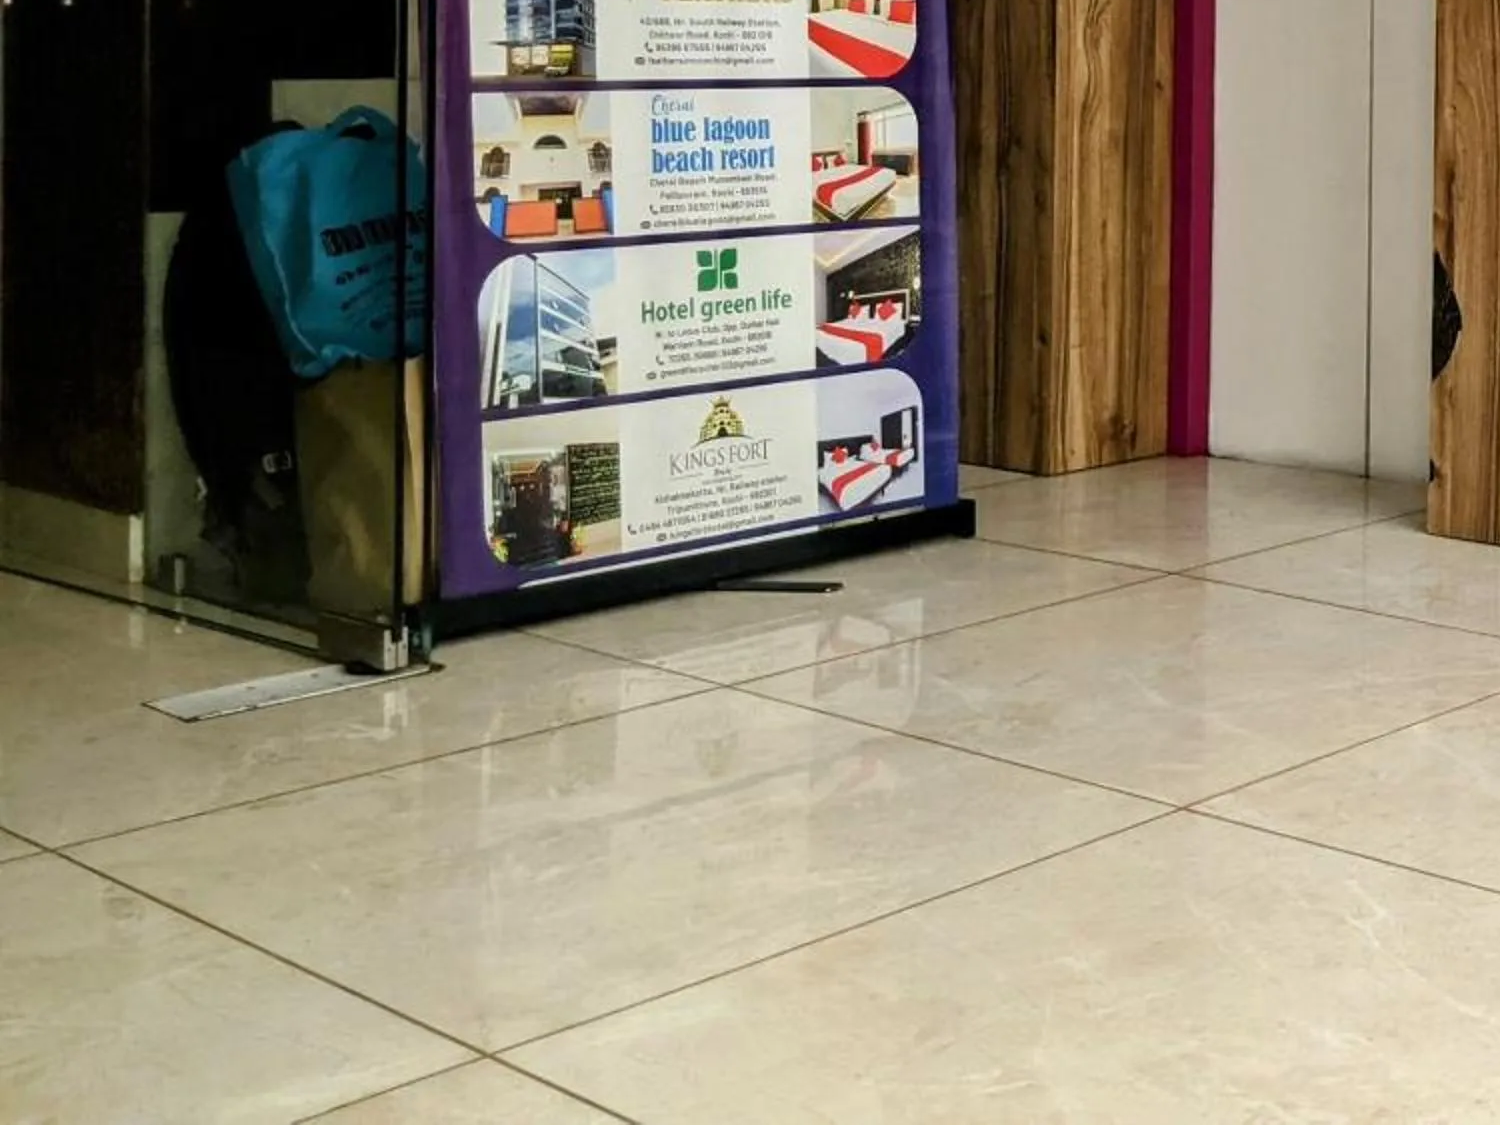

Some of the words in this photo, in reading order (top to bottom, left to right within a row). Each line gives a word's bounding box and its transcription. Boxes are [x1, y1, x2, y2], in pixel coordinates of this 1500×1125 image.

[651, 118, 696, 144] blue
[704, 116, 770, 144] lagoon
[652, 146, 714, 174] beach
[721, 146, 775, 170] resort
[641, 297, 695, 323] Hotel
[701, 295, 757, 323] green
[761, 288, 793, 311] life
[669, 446, 725, 476] KINGS
[729, 438, 774, 464] FORT
